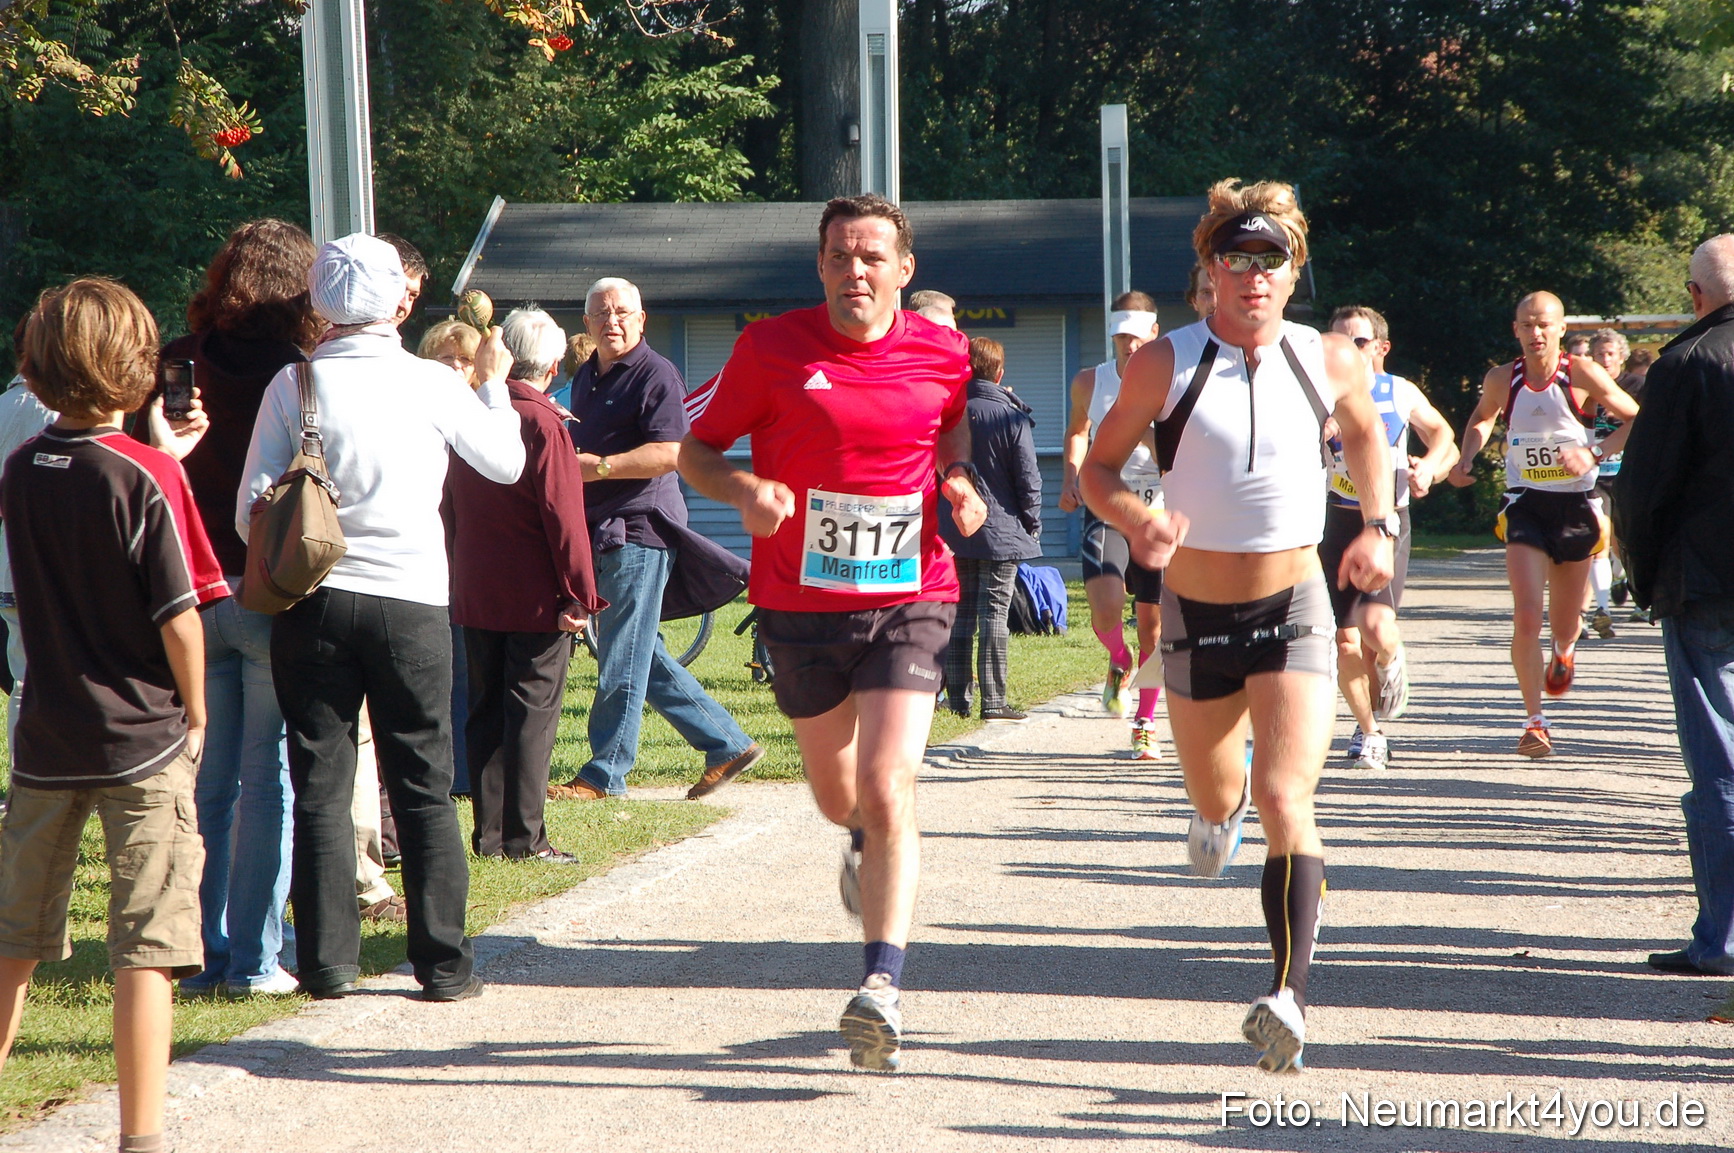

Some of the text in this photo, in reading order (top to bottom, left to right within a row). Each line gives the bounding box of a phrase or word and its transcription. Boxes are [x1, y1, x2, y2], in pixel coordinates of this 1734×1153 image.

[1338, 477, 1357, 494] Ma
[818, 517, 909, 556] 3117
[821, 555, 901, 580] Manfred
